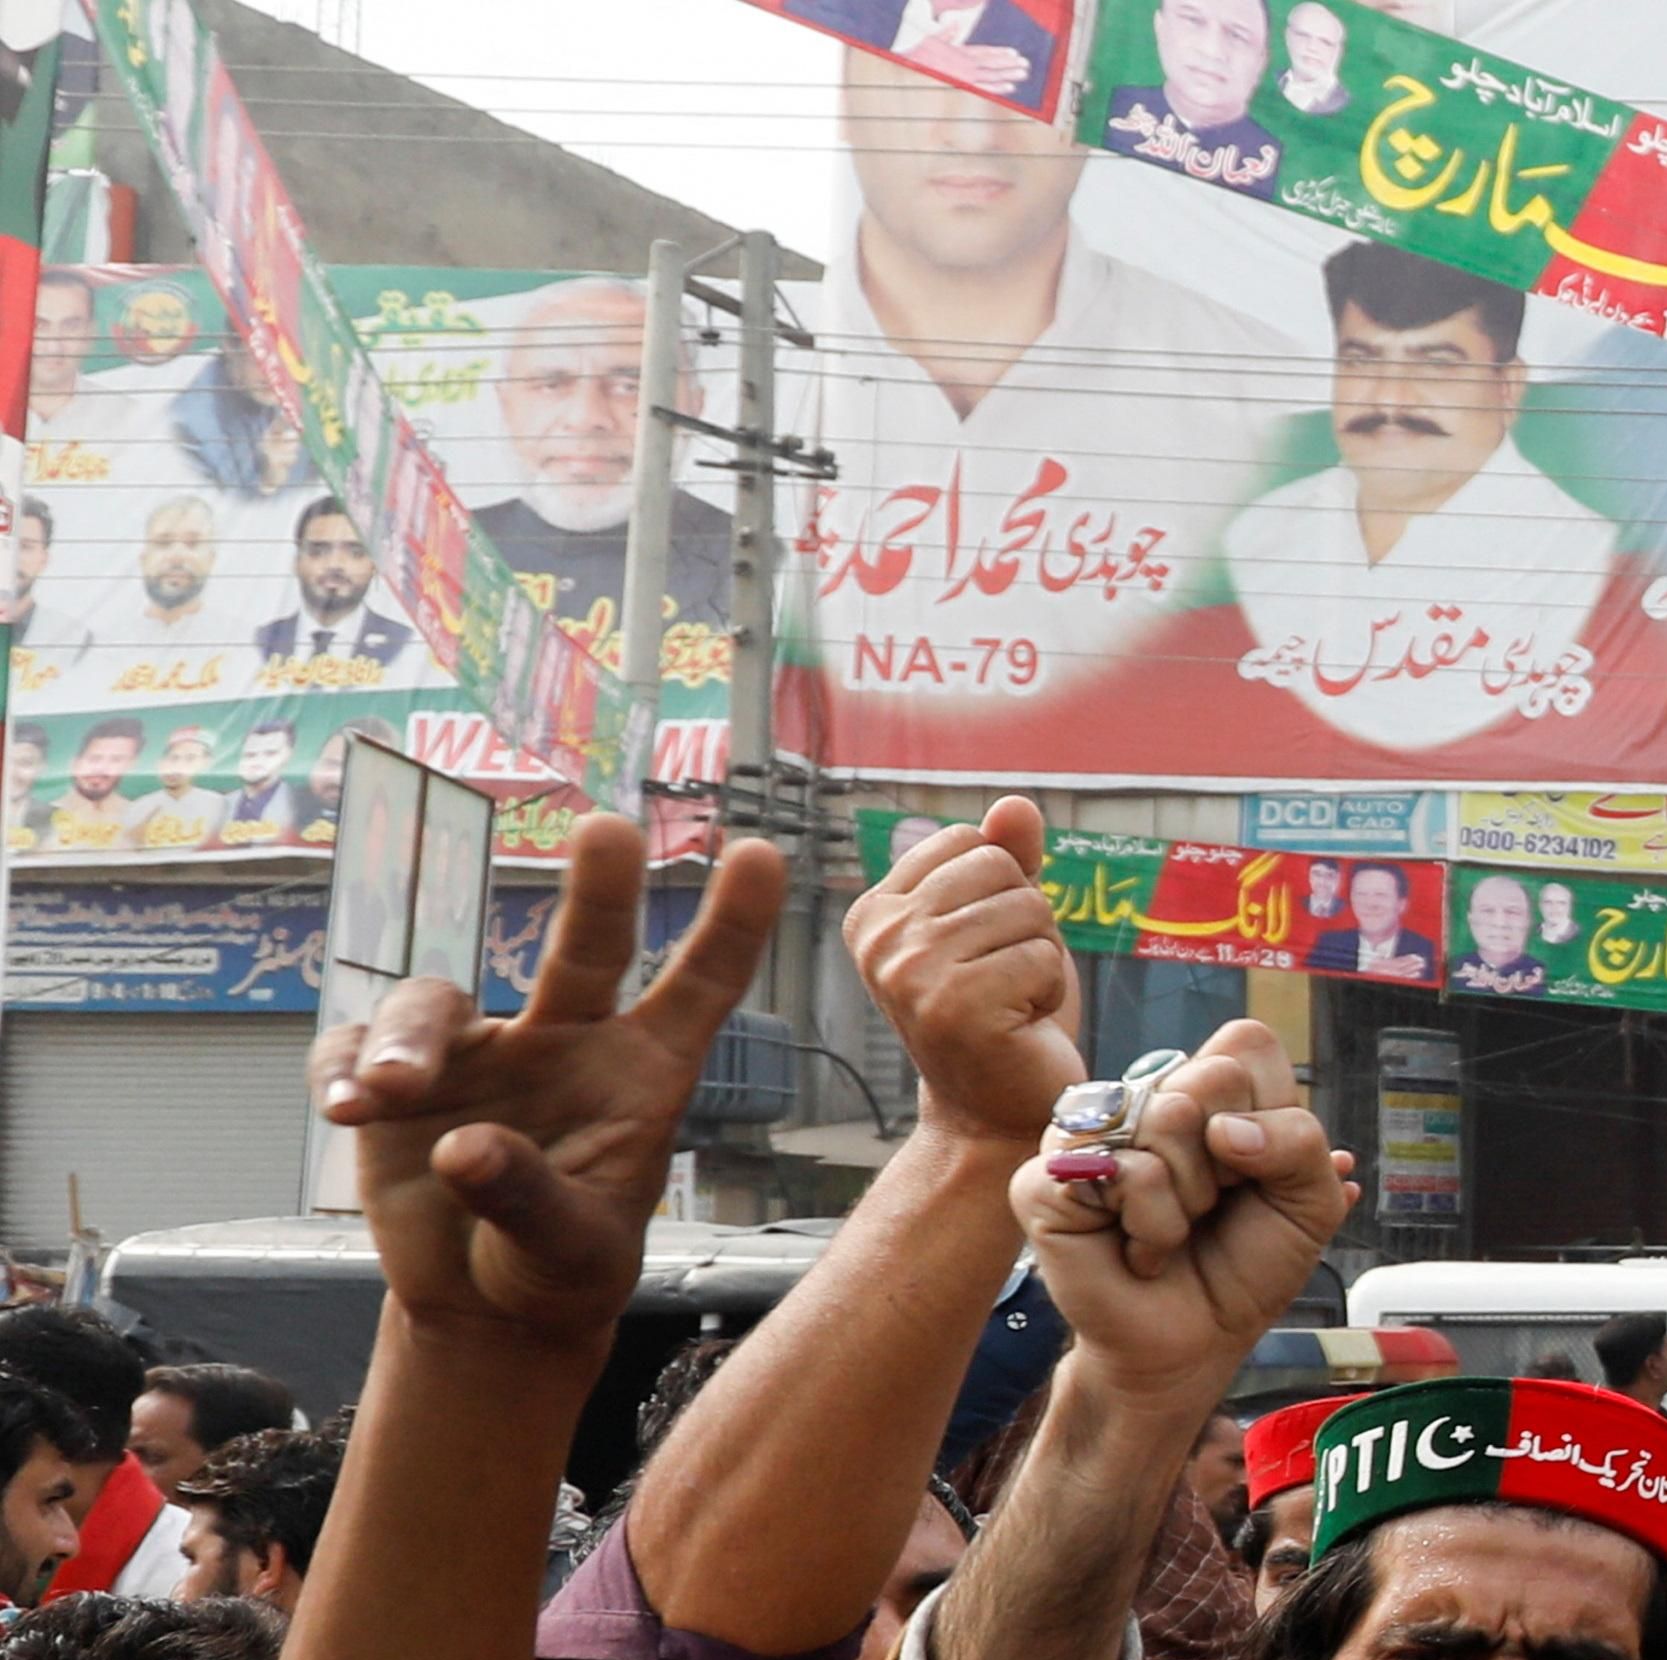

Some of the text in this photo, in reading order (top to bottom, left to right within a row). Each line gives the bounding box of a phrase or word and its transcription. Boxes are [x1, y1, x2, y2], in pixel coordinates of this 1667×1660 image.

[815, 448, 963, 602] احمد
[934, 457, 1069, 605] محمد
[1037, 511, 1169, 602] چوہدری
[852, 633, 1039, 686] NA-79
[1312, 603, 1491, 697] مقدس
[1482, 650, 1591, 712] چوہدری
[1257, 799, 1333, 827] DCD
[1340, 800, 1403, 815] AUTO
[1345, 814, 1397, 830] CAD
[1459, 826, 1617, 860] 0300-6234102
[1130, 852, 1292, 945] لانگ
[1327, 1419, 1409, 1513] PTI
[1484, 1429, 1581, 1469] انصاف
[1577, 1446, 1651, 1493] تحریک
